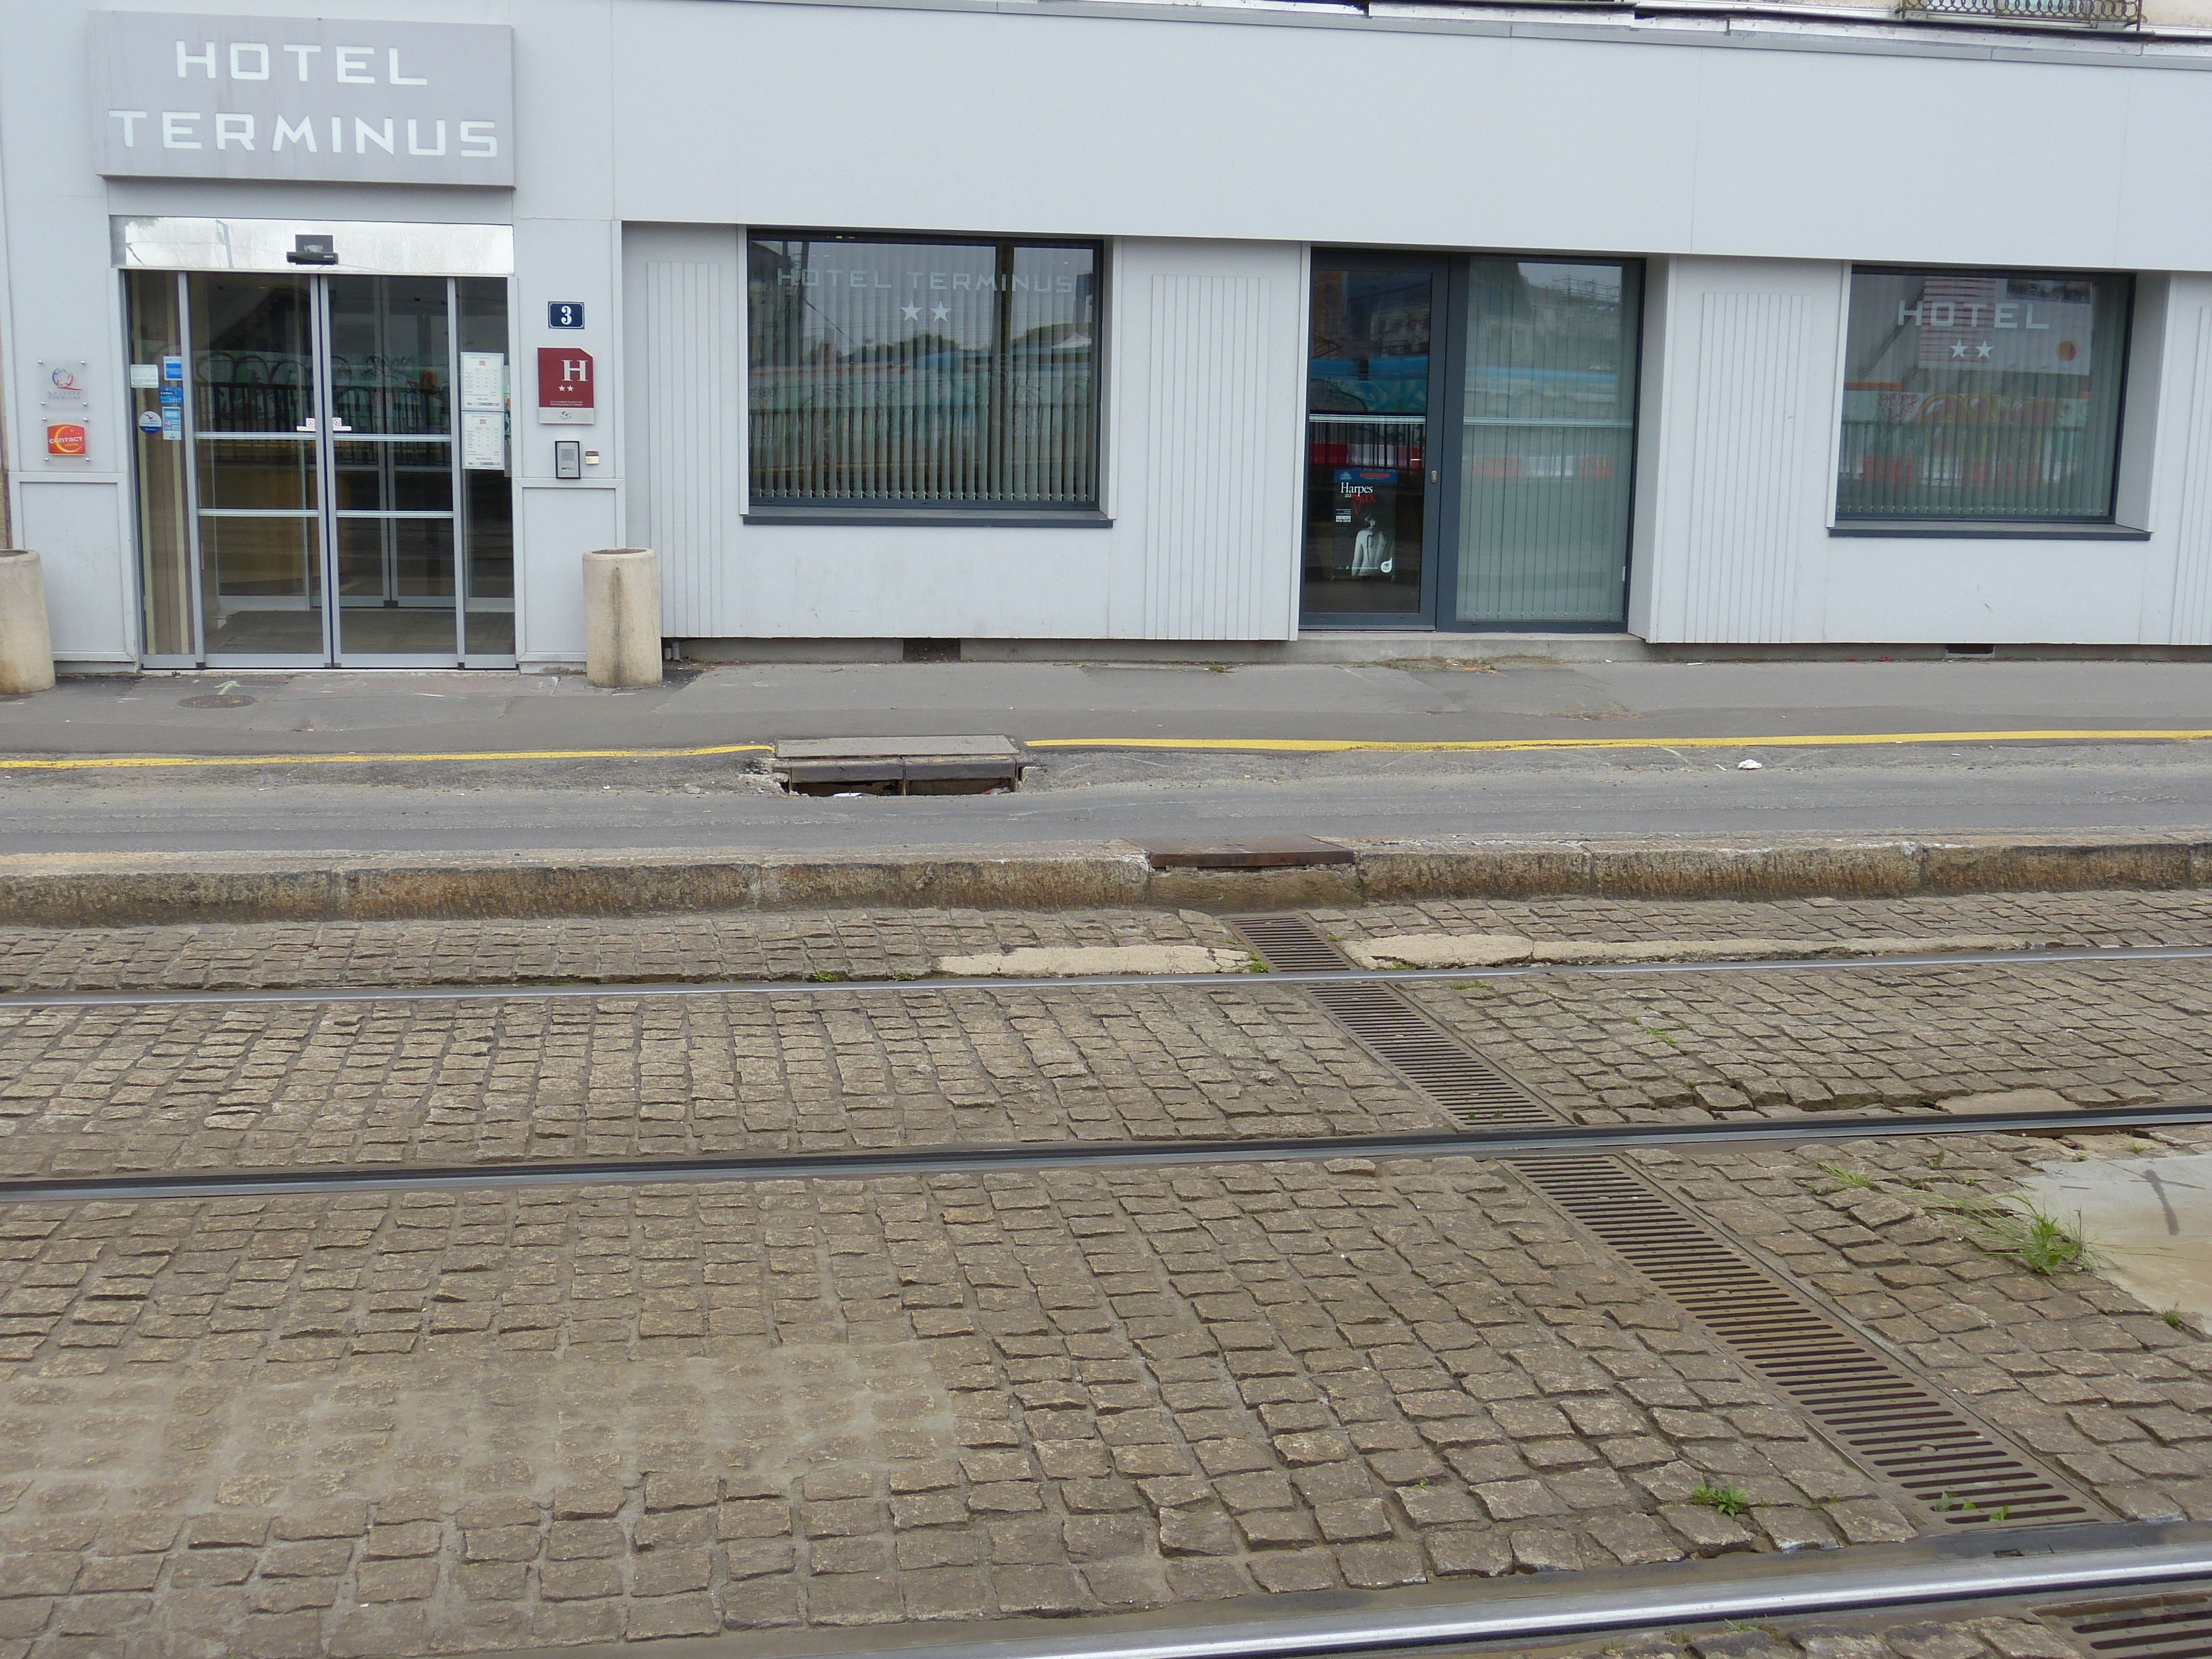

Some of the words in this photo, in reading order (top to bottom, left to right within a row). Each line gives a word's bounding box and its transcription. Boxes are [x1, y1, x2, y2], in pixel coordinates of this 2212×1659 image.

[176, 40, 427, 86] HOTEL
[108, 109, 498, 158] TERMINUS
[777, 267, 892, 289] HOTEL
[907, 271, 1073, 293] TERMINUS
[560, 305, 573, 325] 3
[1898, 300, 2050, 329] HOTEL
[562, 359, 588, 381] H
[1340, 482, 1373, 497] Harpes
